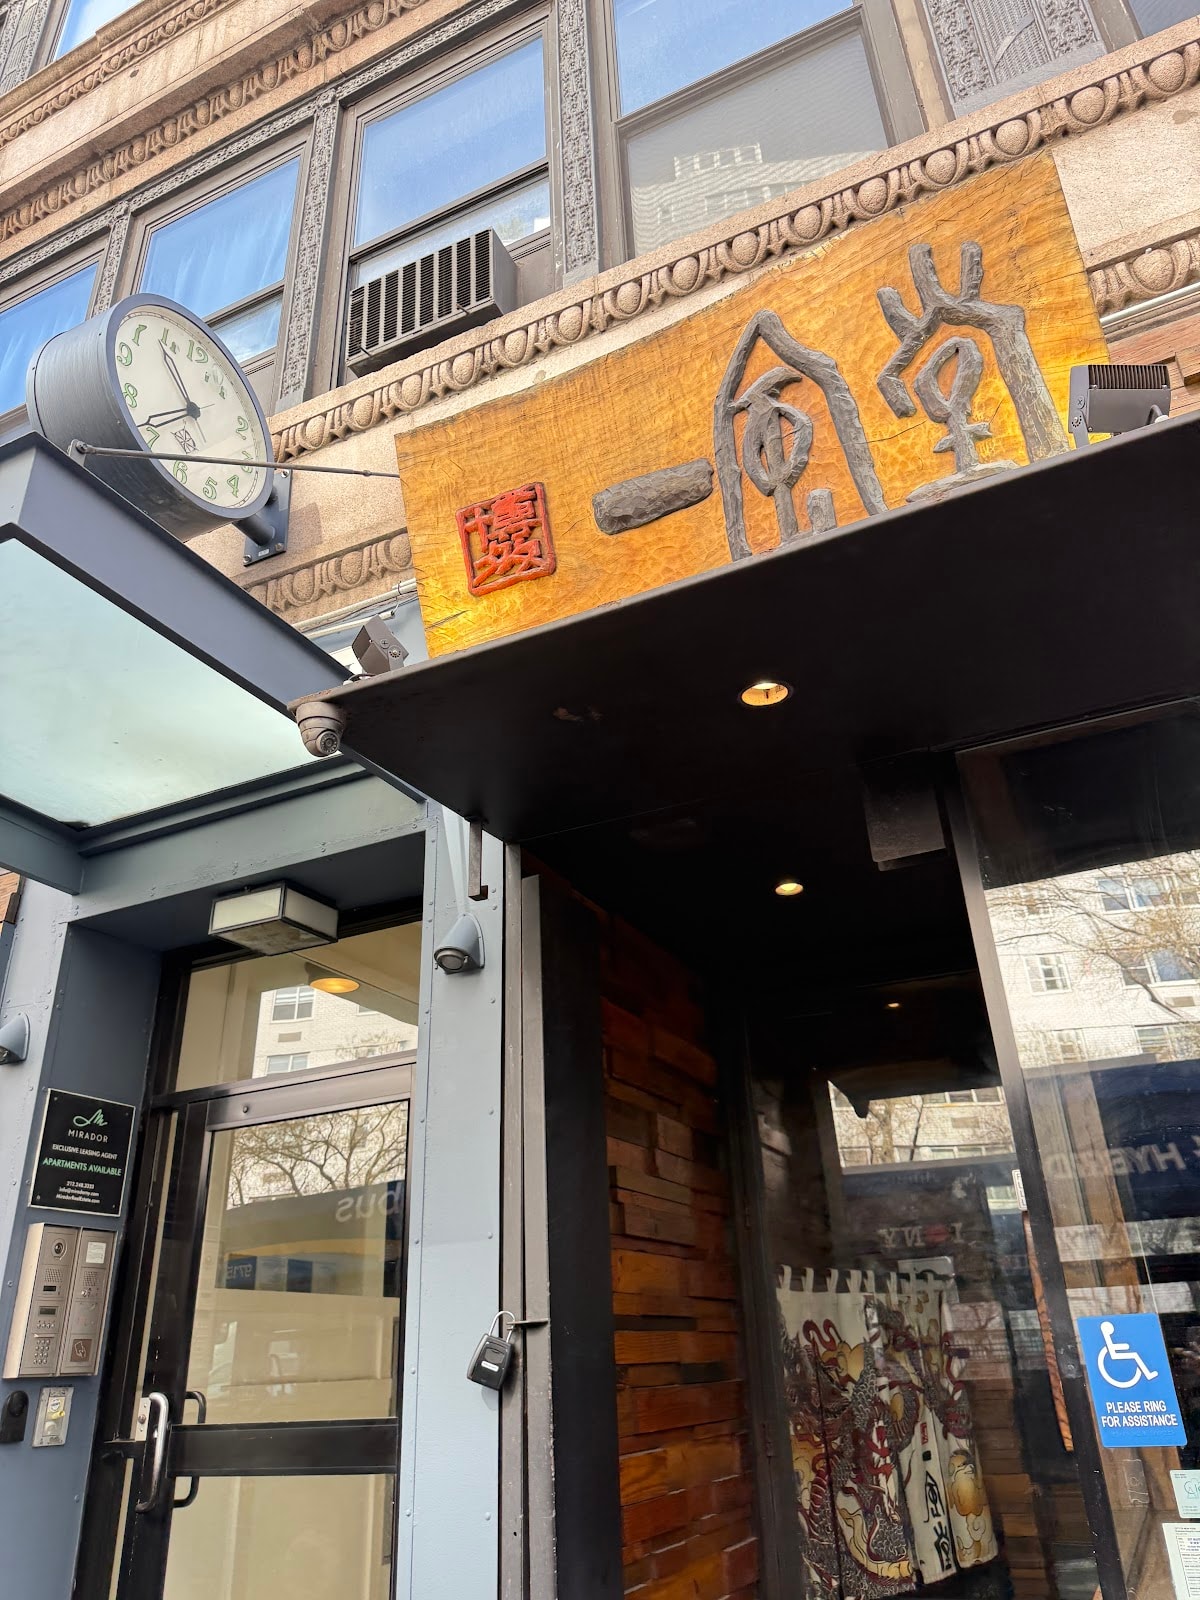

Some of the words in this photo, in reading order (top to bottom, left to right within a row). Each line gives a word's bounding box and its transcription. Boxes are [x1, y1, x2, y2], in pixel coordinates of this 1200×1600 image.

[116, 341, 133, 366] 9
[186, 339, 209, 364] 12
[123, 382, 138, 409] 8
[235, 415, 249, 441] 2
[173, 459, 188, 485] 6
[203, 476, 218, 501] 5
[227, 475, 240, 499] 4
[67, 1128, 109, 1143] MIRADOR
[52, 1143, 79, 1154] EXCLUSIVE
[79, 1148, 101, 1158] LEASING
[101, 1153, 118, 1161] AGENT
[42, 1157, 88, 1172] APARTMENTS
[88, 1164, 122, 1177] AVAILABLE
[1106, 1401, 1142, 1414] PLEASE
[1144, 1400, 1167, 1412] RING
[1101, 1416, 1121, 1428] FOR
[1122, 1413, 1178, 1427] ASSISTANCE
